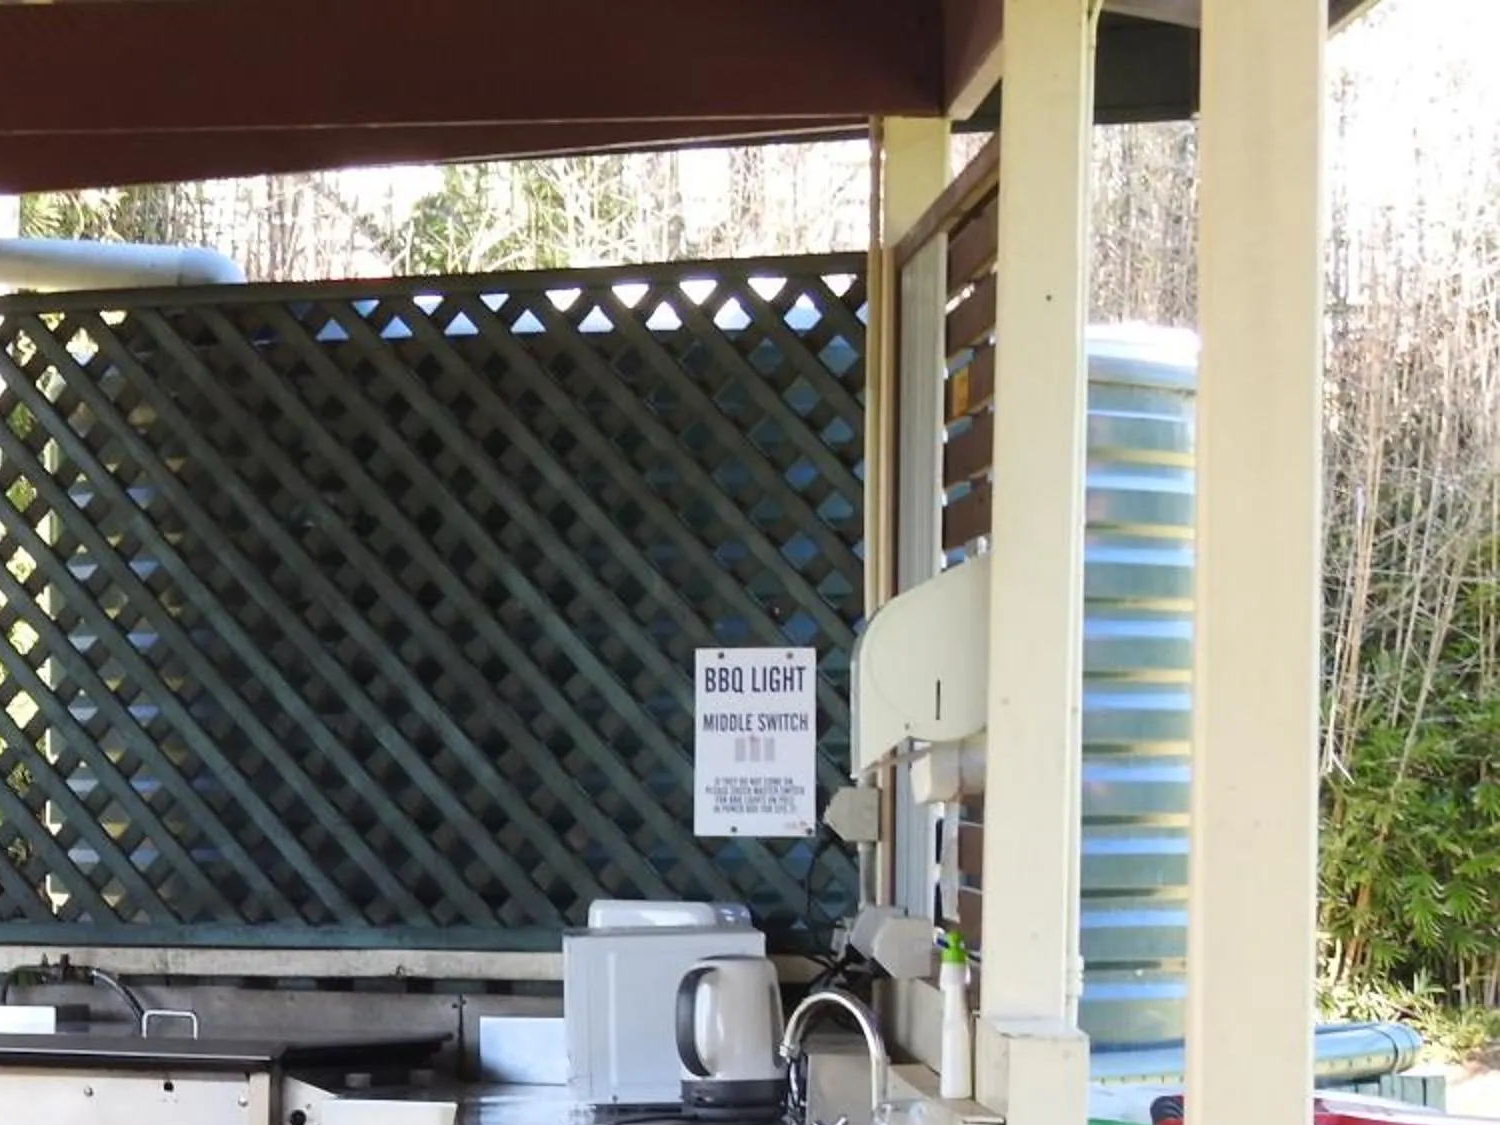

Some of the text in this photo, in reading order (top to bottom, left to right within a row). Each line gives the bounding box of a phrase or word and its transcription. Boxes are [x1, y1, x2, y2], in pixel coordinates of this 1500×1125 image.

[705, 666, 807, 694] BBQ LIGHT
[703, 713, 809, 732] MIDDLE SWITCH
